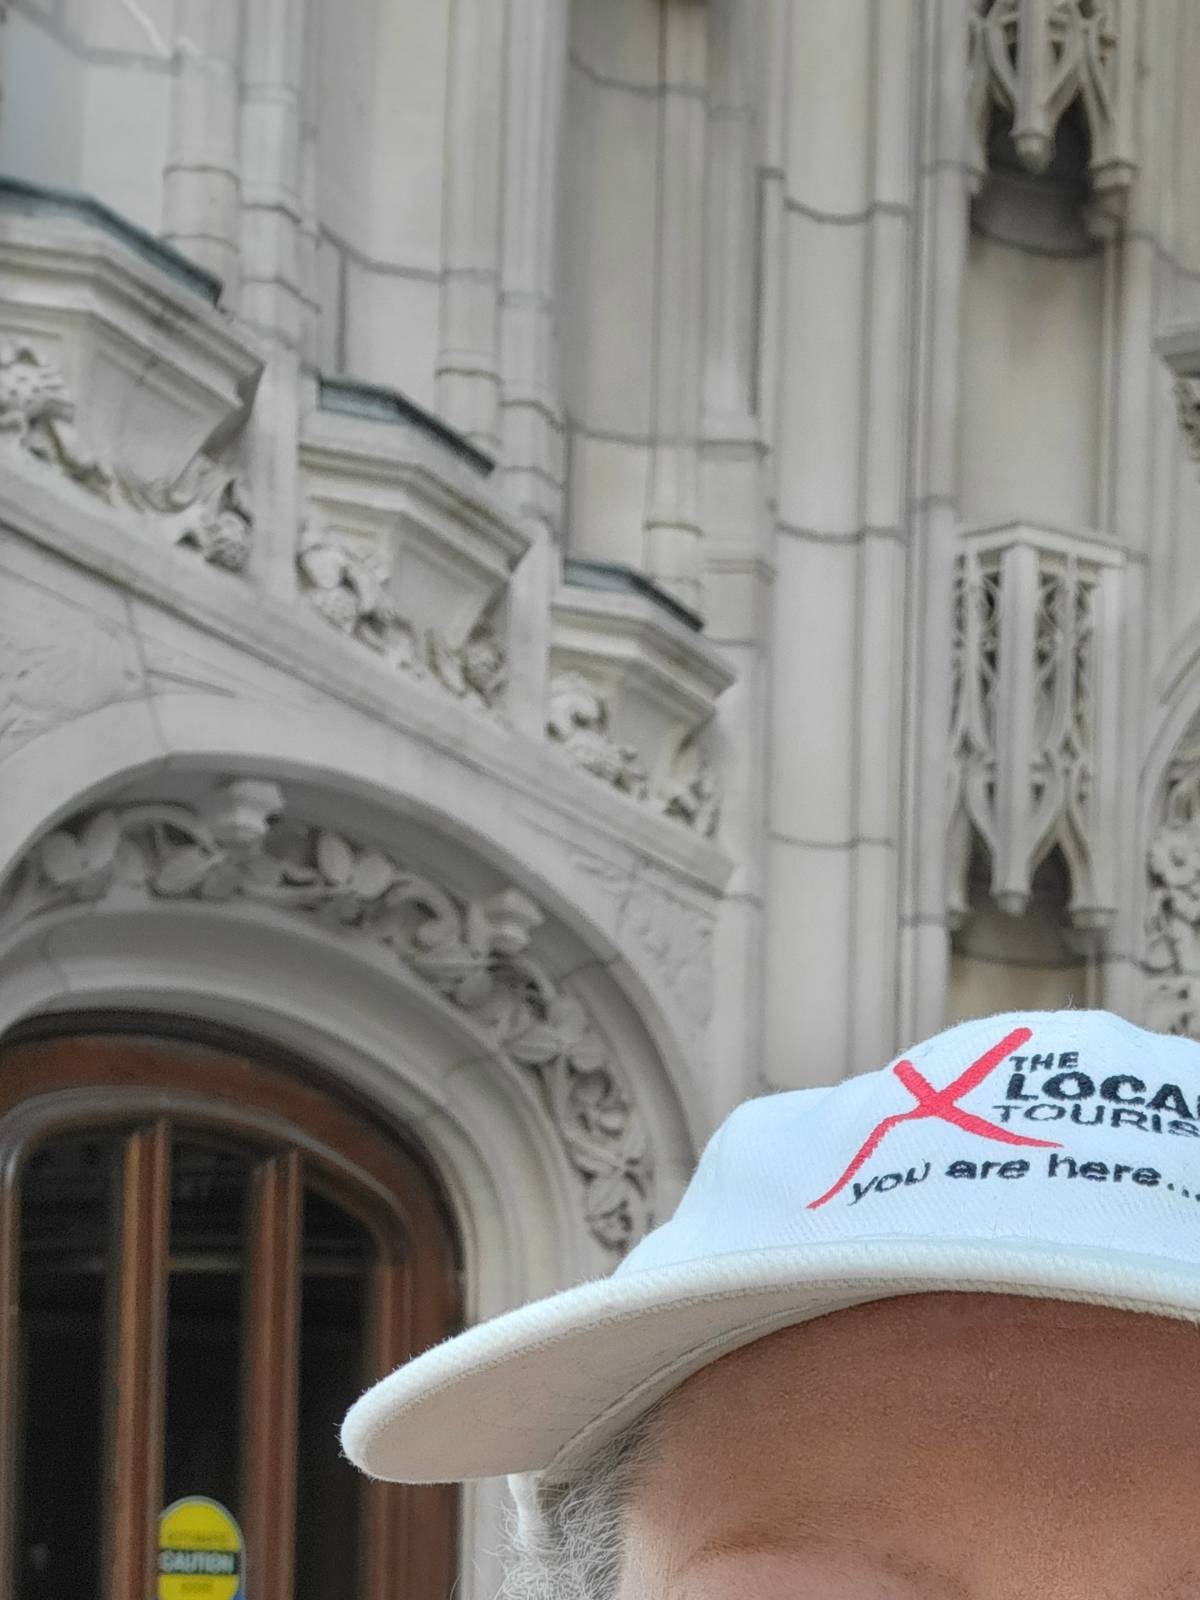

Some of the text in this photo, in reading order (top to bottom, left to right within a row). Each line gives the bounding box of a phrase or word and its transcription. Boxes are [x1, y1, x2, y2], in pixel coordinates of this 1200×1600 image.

[1009, 1051, 1079, 1072] THE
[849, 1161, 931, 1206] you
[945, 1157, 1030, 1181] are
[161, 1552, 234, 1573] CAUTION
